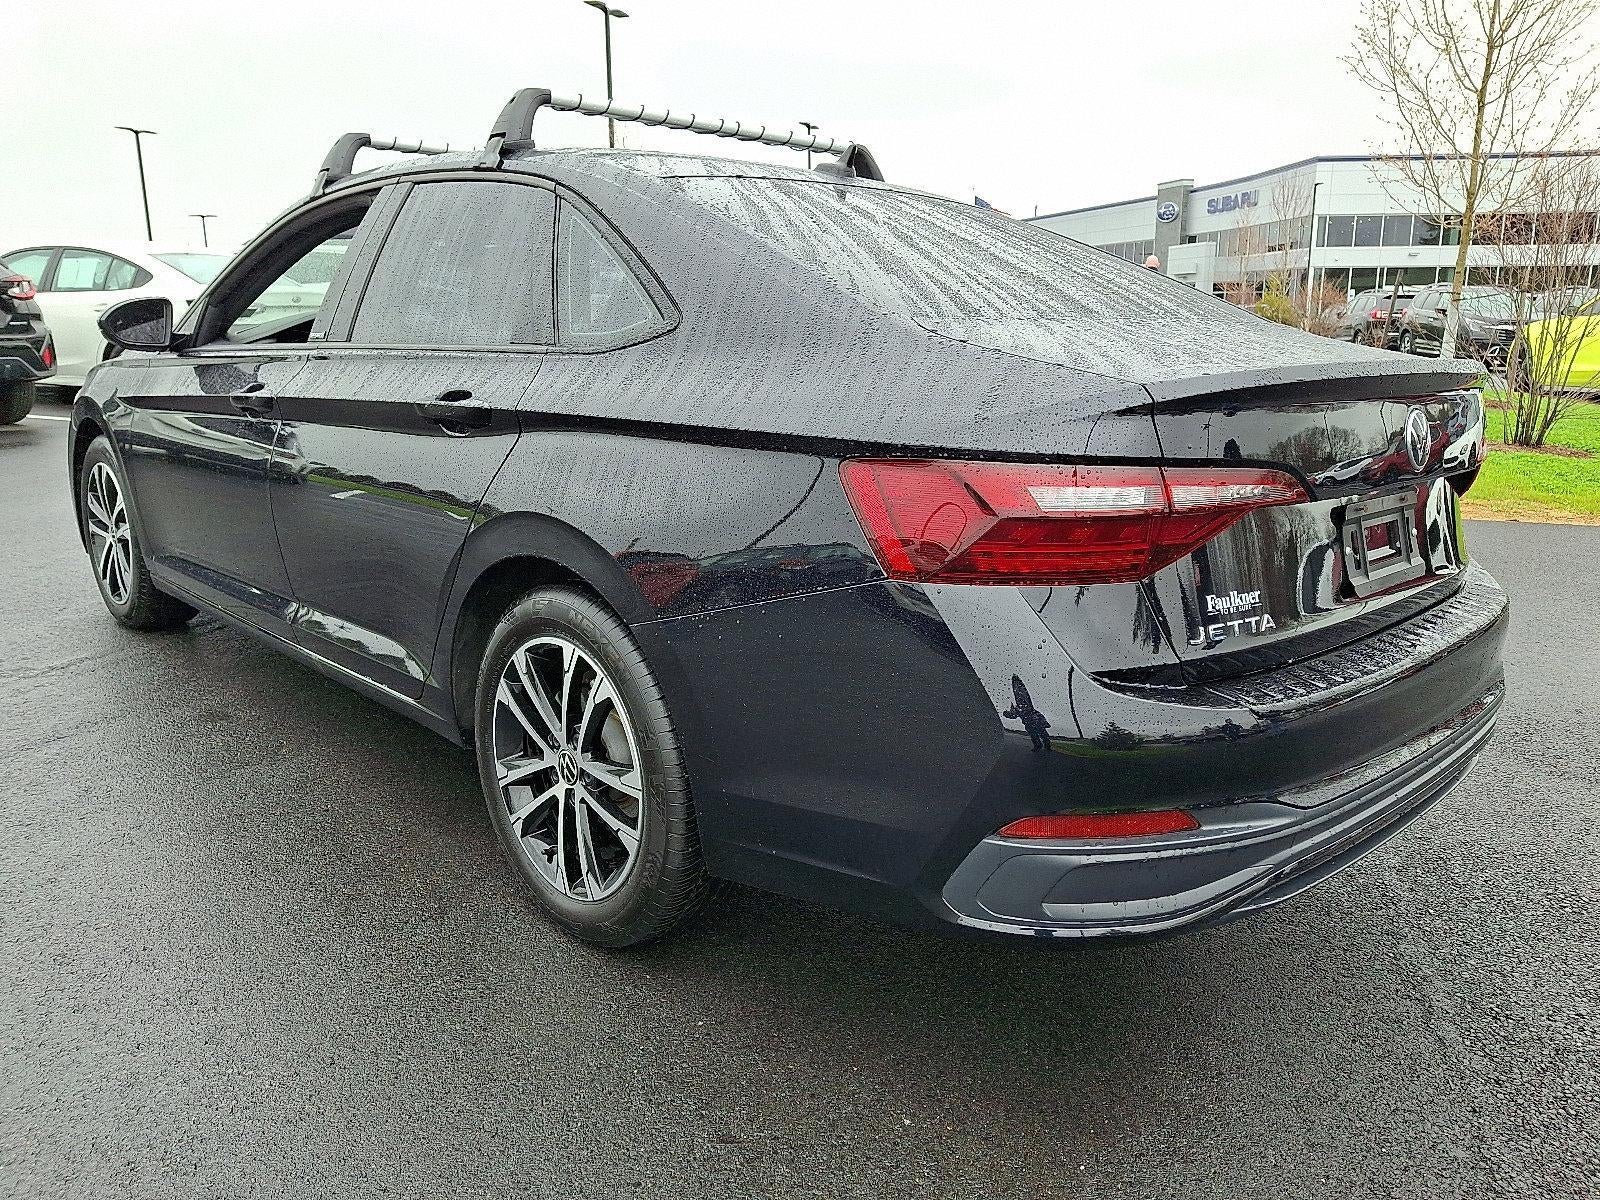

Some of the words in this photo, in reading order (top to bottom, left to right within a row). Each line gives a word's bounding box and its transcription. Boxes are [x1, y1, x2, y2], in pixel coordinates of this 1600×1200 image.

[1207, 189, 1258, 214] SUBARU
[1205, 590, 1261, 612] Faulkner
[1239, 603, 1253, 612] SURE
[1190, 613, 1277, 645] JETTA
